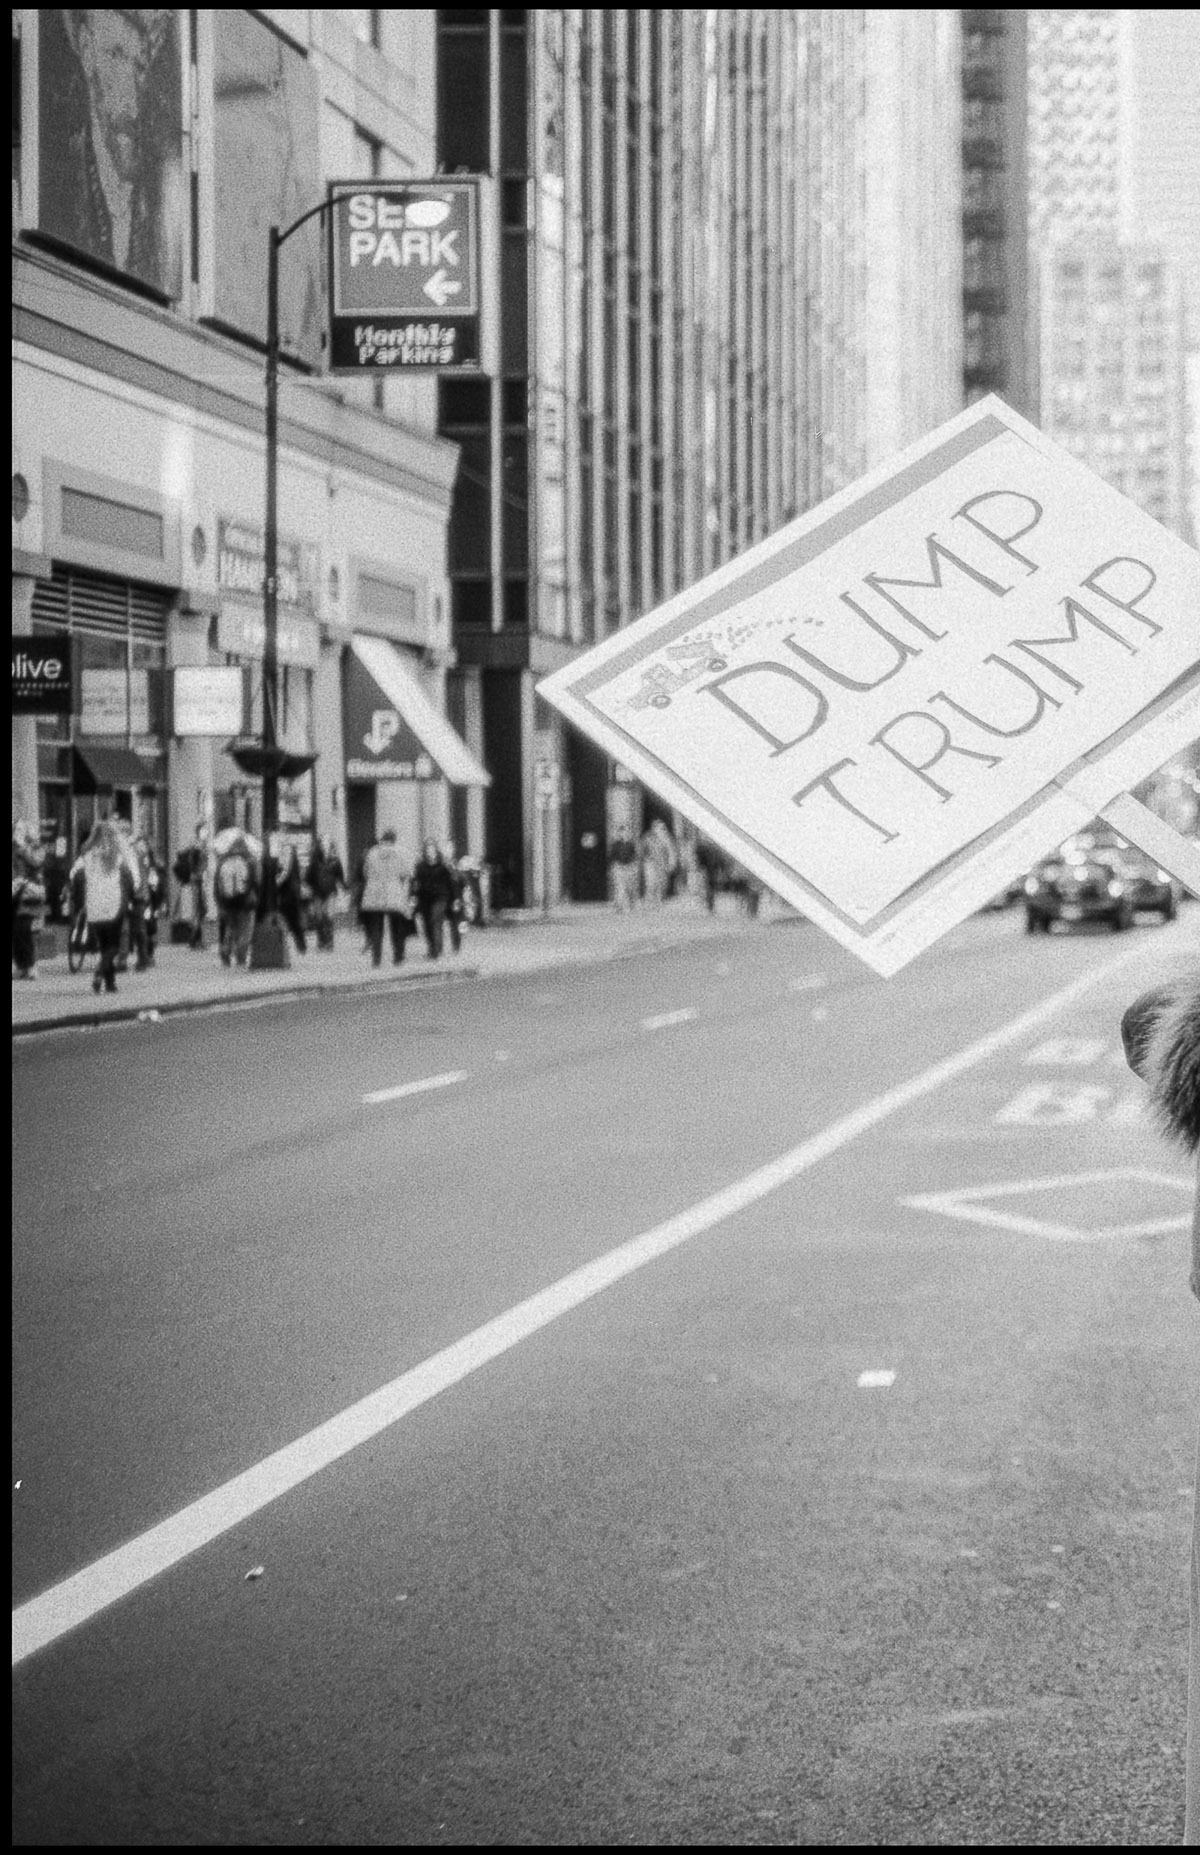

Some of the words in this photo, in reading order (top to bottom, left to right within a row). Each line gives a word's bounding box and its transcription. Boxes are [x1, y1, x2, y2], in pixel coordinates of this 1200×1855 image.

[348, 194, 454, 229] SE
[350, 230, 459, 266] PARK
[354, 323, 456, 346] Monthly
[358, 345, 455, 364] Parking
[697, 490, 1043, 757] DUMP
[12, 653, 62, 679] live
[792, 556, 1164, 844] TRUMP
